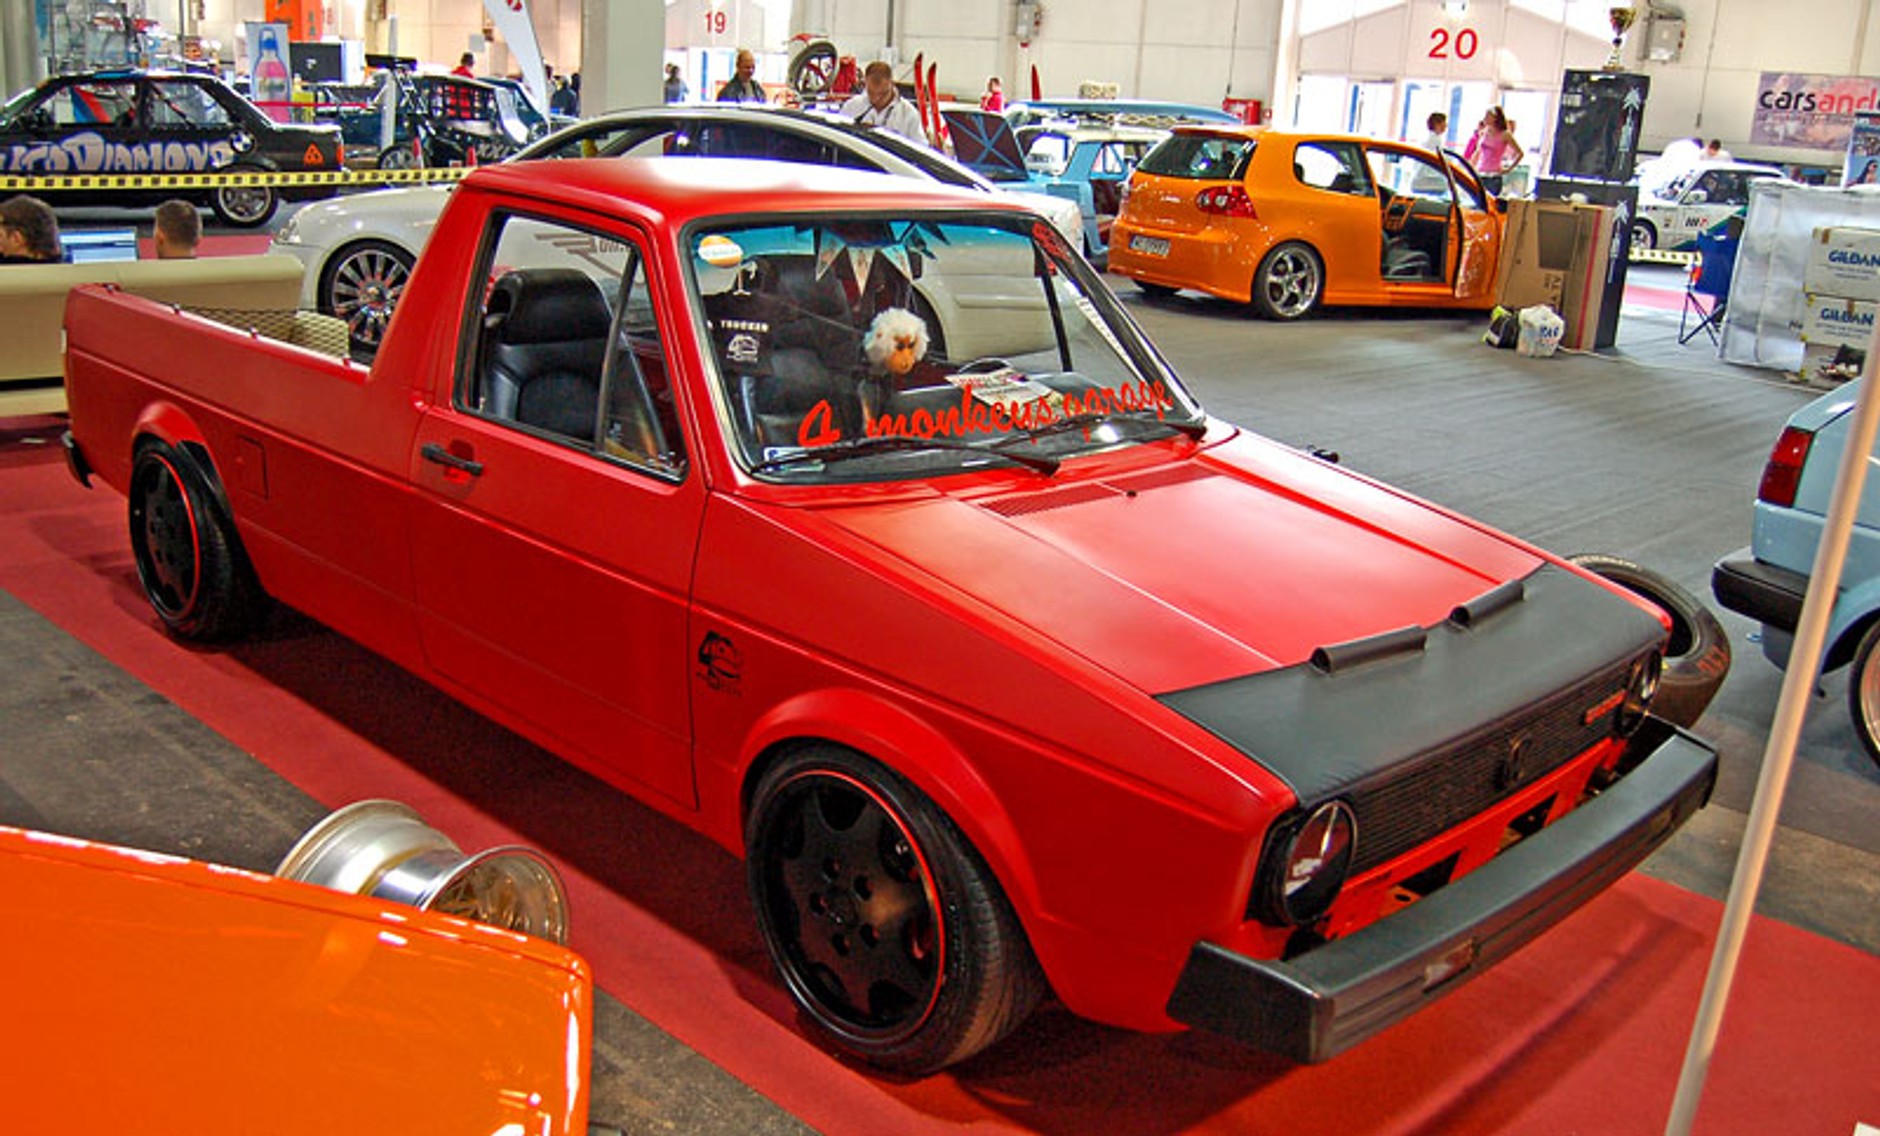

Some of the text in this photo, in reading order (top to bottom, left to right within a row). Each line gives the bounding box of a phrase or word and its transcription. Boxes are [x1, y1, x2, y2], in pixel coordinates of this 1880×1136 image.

[704, 11, 726, 33] 19
[1428, 28, 1478, 59] 20
[1760, 87, 1880, 113] carsand
